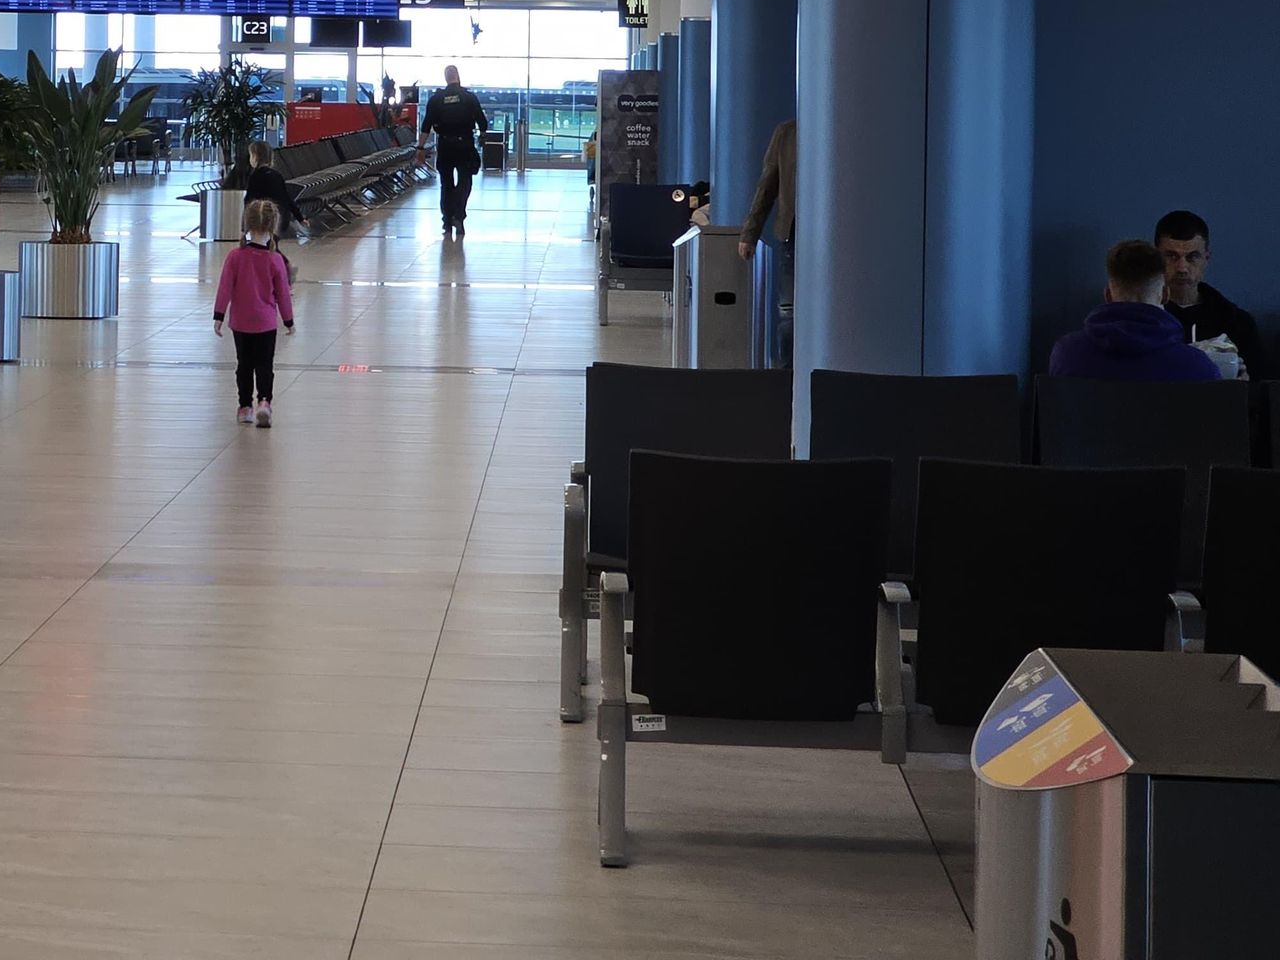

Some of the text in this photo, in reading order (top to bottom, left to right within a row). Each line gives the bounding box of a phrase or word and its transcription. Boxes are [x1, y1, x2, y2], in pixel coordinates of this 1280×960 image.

[243, 21, 267, 34] C23
[626, 123, 651, 132] coffee
[627, 138, 650, 146] snack
